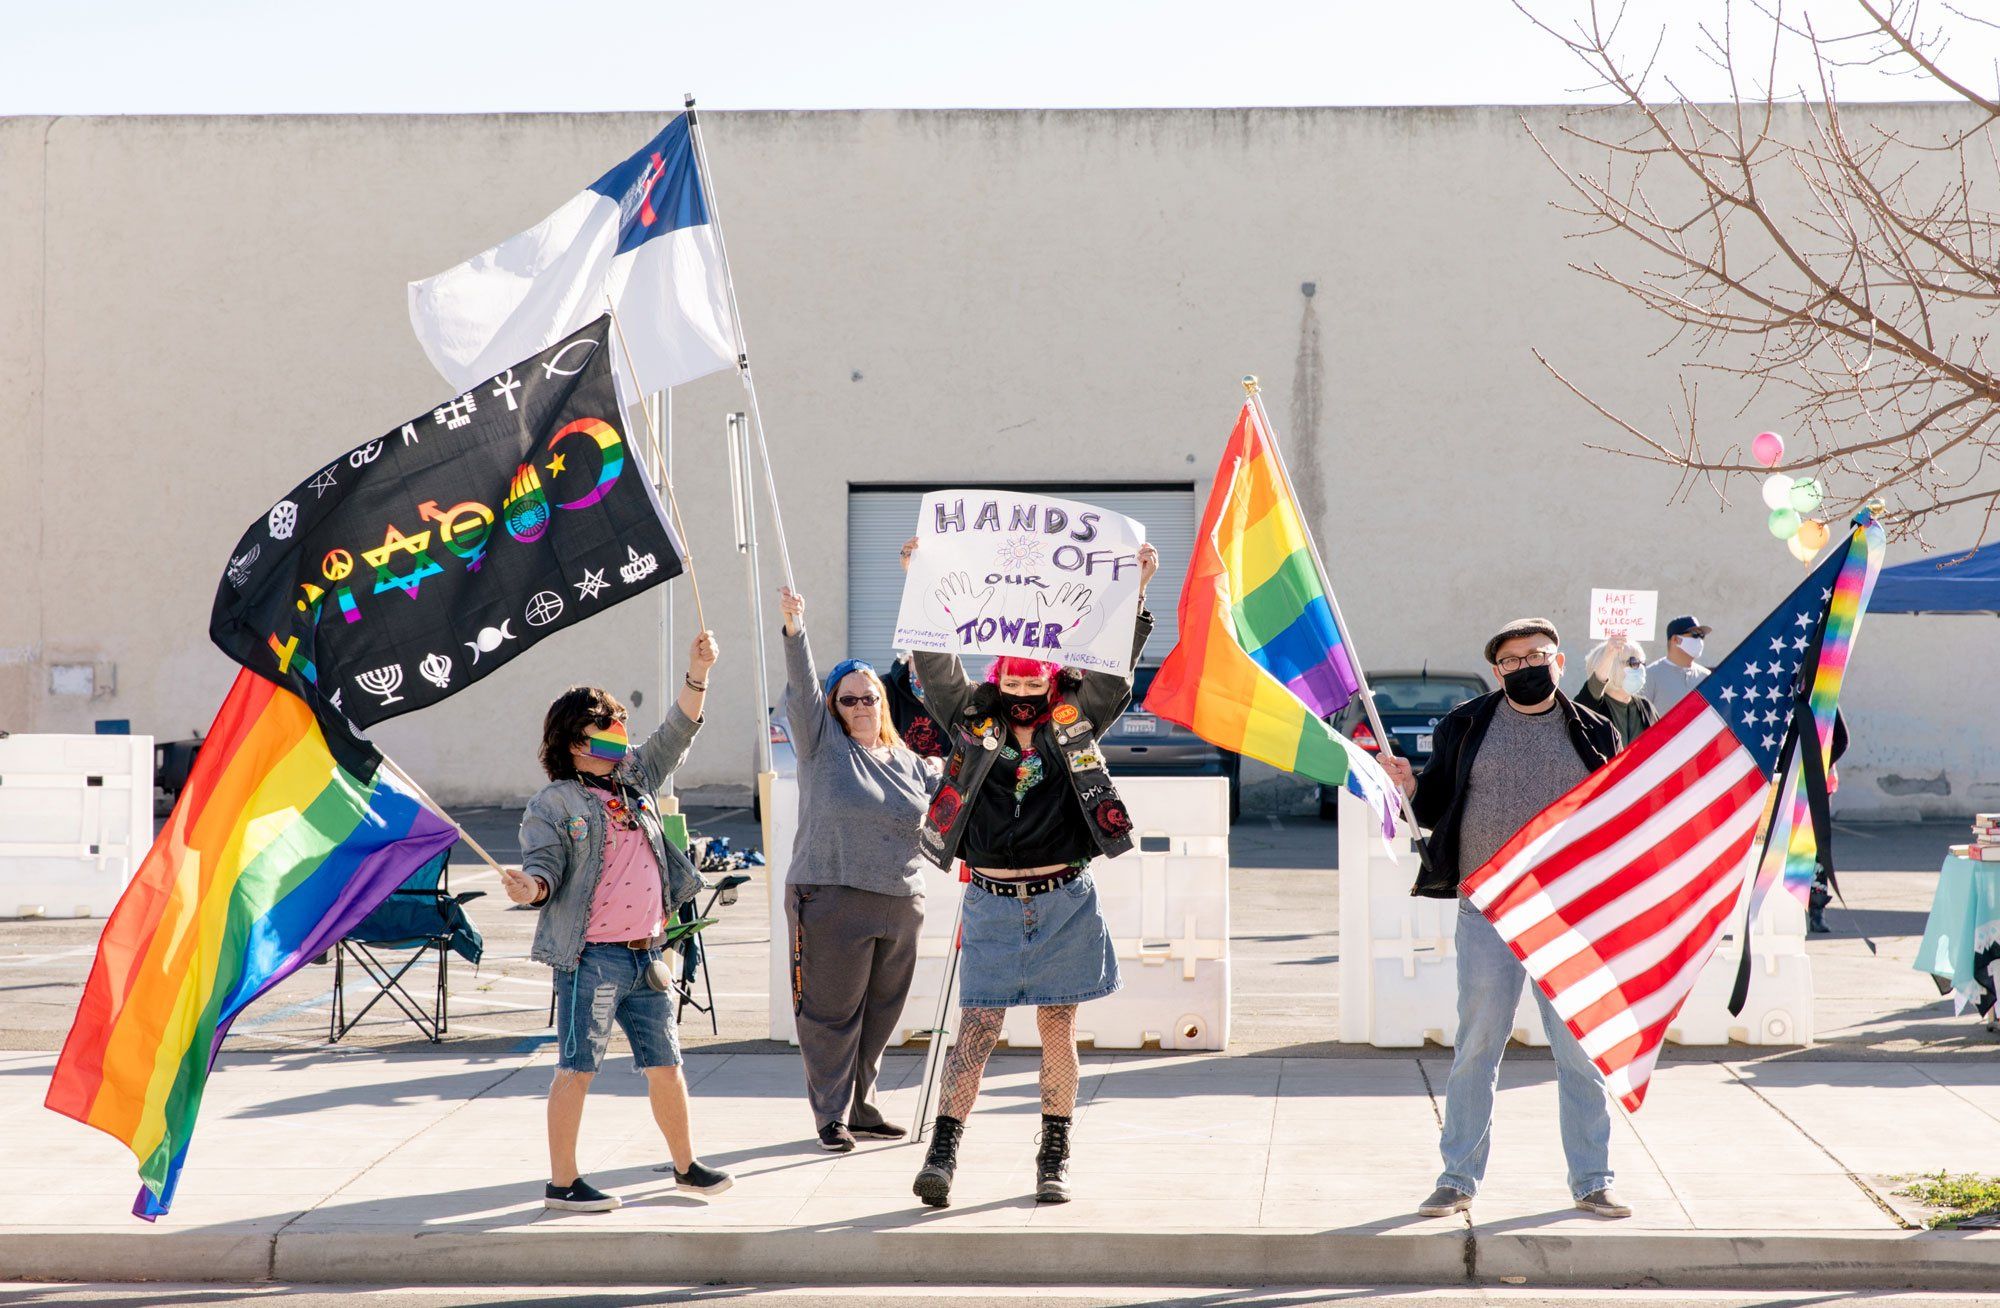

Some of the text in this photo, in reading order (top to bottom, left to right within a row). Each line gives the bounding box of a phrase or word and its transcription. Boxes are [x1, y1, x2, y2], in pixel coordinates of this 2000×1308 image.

[935, 499, 1100, 542] HANDS
[1053, 545, 1137, 581] OFF
[985, 574, 1049, 588] OUR
[1606, 593, 1636, 604] HATE
[1599, 607, 1631, 616] IS NOT
[1598, 618, 1645, 626] WELCOME
[956, 615, 1063, 649] TOWER
[1604, 628, 1628, 637] HERE
